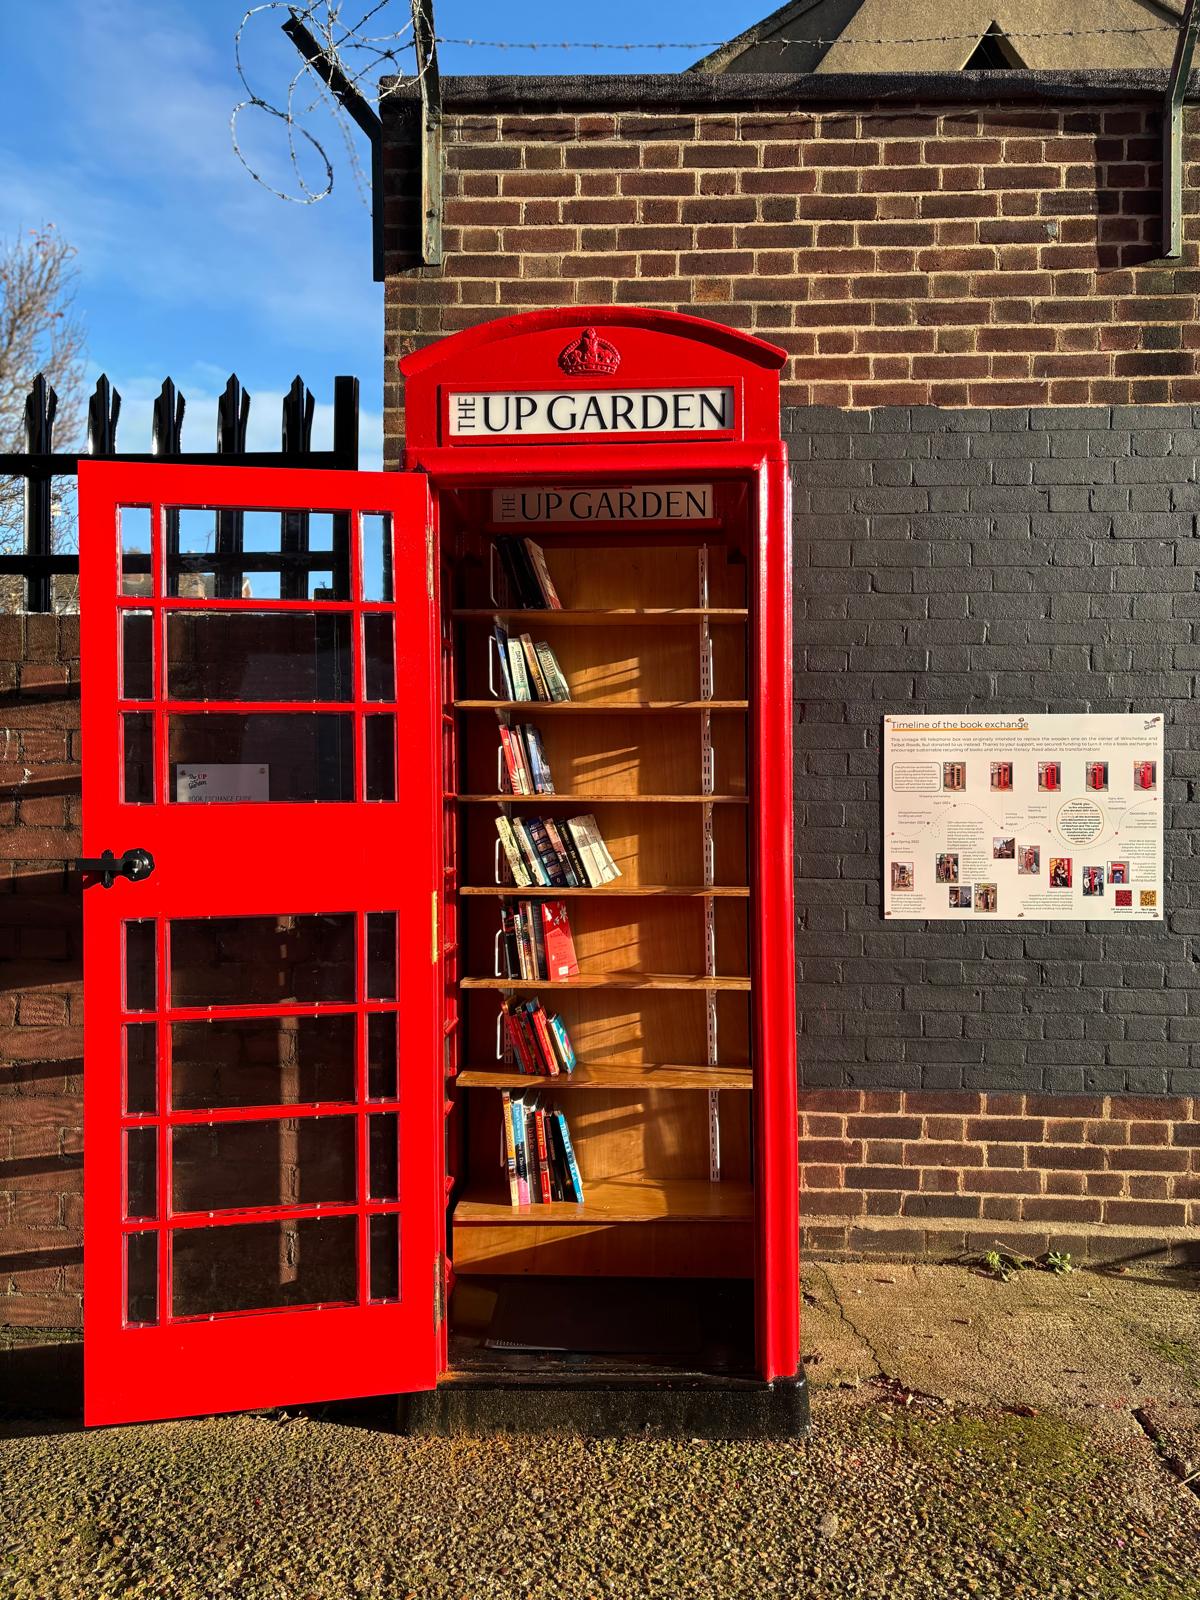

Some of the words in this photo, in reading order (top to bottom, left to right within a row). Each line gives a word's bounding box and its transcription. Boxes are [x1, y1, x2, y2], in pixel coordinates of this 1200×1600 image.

[457, 396, 476, 432] THE
[482, 395, 538, 432] UP
[546, 392, 727, 431] GARDEN
[501, 494, 515, 520] THE
[520, 492, 563, 521] UP
[569, 490, 707, 519] GARDEN
[891, 721, 930, 729] Timeline
[932, 720, 941, 728] of
[942, 720, 958, 728] the
[960, 720, 983, 728] book
[984, 720, 1029, 730] exchange
